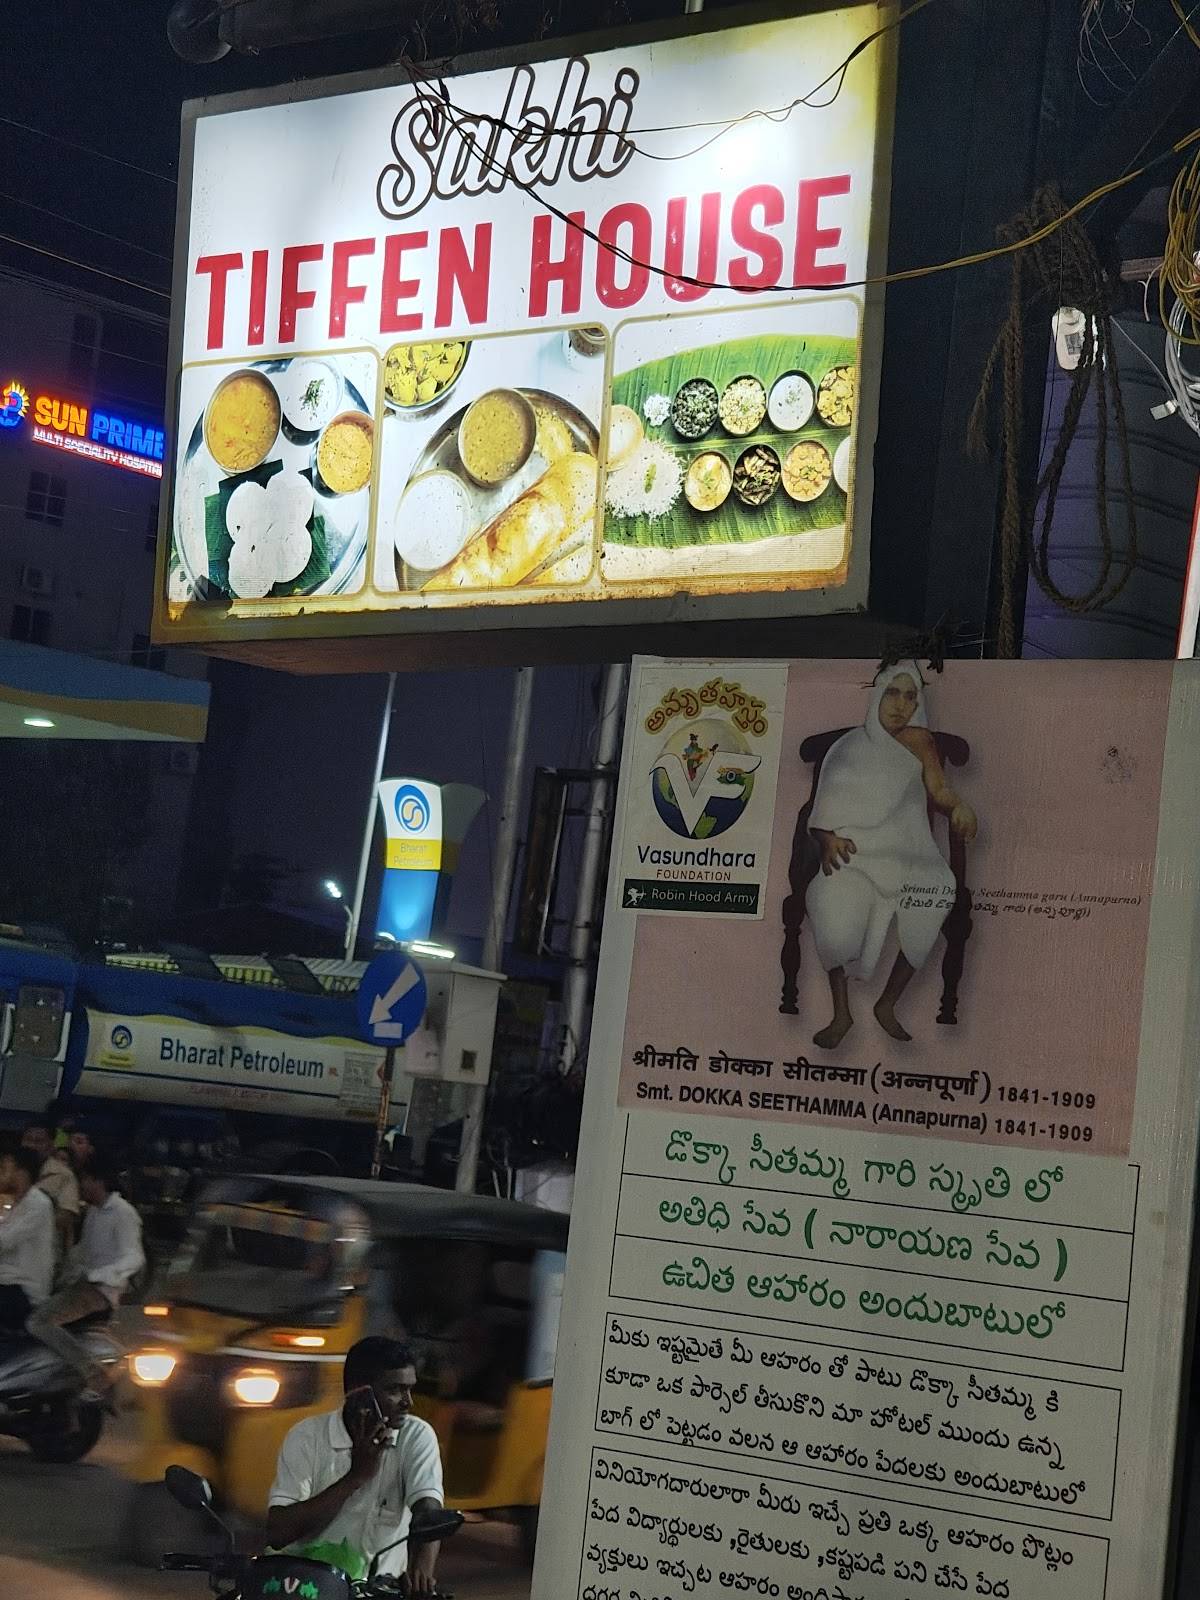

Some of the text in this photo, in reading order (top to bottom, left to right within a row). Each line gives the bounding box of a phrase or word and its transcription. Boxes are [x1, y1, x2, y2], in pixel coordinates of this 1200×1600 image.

[377, 56, 639, 220] Sakhi
[196, 174, 852, 350] TIFFEN HOUSE
[33, 428, 64, 449] MULTI
[34, 396, 164, 460] SUN PRIME
[400, 842, 427, 854] Bharat
[637, 845, 756, 868] Vasundhara
[656, 869, 731, 881] FOUNDATION
[651, 888, 756, 906] Robin Hood Army
[901, 883, 938, 896] Srimati
[979, 887, 1040, 900] Seethamma
[1040, 891, 1067, 903] garu
[1069, 892, 1142, 906] (Annapurna)
[160, 1036, 224, 1068] Bharat
[231, 1050, 324, 1079] Petroleum
[632, 1044, 699, 1071] श्रीमति
[709, 1050, 774, 1077] डोक्का
[783, 1056, 868, 1086] सीतम्मा
[998, 1086, 1095, 1109] 1841-1909
[636, 1082, 1092, 1142] Smt. DOKKA SEETHAMMA (Annapurna) 1841-1909
[665, 1130, 736, 1185] డొక్కా
[750, 1133, 850, 1198] సీతమ్మ
[864, 1159, 916, 1187] గారి
[1025, 1165, 1064, 1202] లో
[659, 1196, 730, 1233] అతిధి
[742, 1200, 791, 1237] సేవ
[829, 1221, 972, 1260] నారాయణ
[986, 1229, 1040, 1269] సేవ
[662, 1257, 734, 1293] ఉచిత
[859, 1291, 1066, 1339] అందుబాటులో
[609, 1319, 649, 1348] మీకు
[730, 1337, 753, 1364] మీ
[829, 1354, 848, 1378] తో
[855, 1358, 902, 1387] పాటు
[910, 1369, 959, 1408] డొక్కా
[967, 1374, 1037, 1421] సీతమ్మ
[1045, 1390, 1059, 1412] కి
[605, 1366, 1065, 1470] కూడా ఒక పార్సెల్ తీసుకొని మా హోటల్ ముందు ఉన్న
[601, 1406, 633, 1427] బాగ్
[640, 1408, 661, 1431] లో
[667, 1416, 722, 1447] పెట్టడం
[729, 1427, 774, 1451] వలన
[782, 1439, 798, 1455] ఆ
[876, 1449, 946, 1482] పేదలకు
[954, 1470, 1086, 1504] అందుబాటులో
[595, 1459, 750, 1502] వినియోగదారులారా
[757, 1483, 801, 1514] మీరు
[808, 1500, 850, 1536] ఇచ్చే
[858, 1509, 891, 1534] ప్రతి
[899, 1520, 939, 1553] ఒక్క
[1022, 1533, 1074, 1572] పొట్లం
[587, 1543, 648, 1574] వ్యక్తులు
[656, 1559, 712, 1592] ఇచ్చట
[591, 1498, 620, 1523] పేద
[894, 1560, 927, 1583] పని
[934, 1565, 968, 1591] చేసే
[976, 1571, 1009, 1599] పేద
